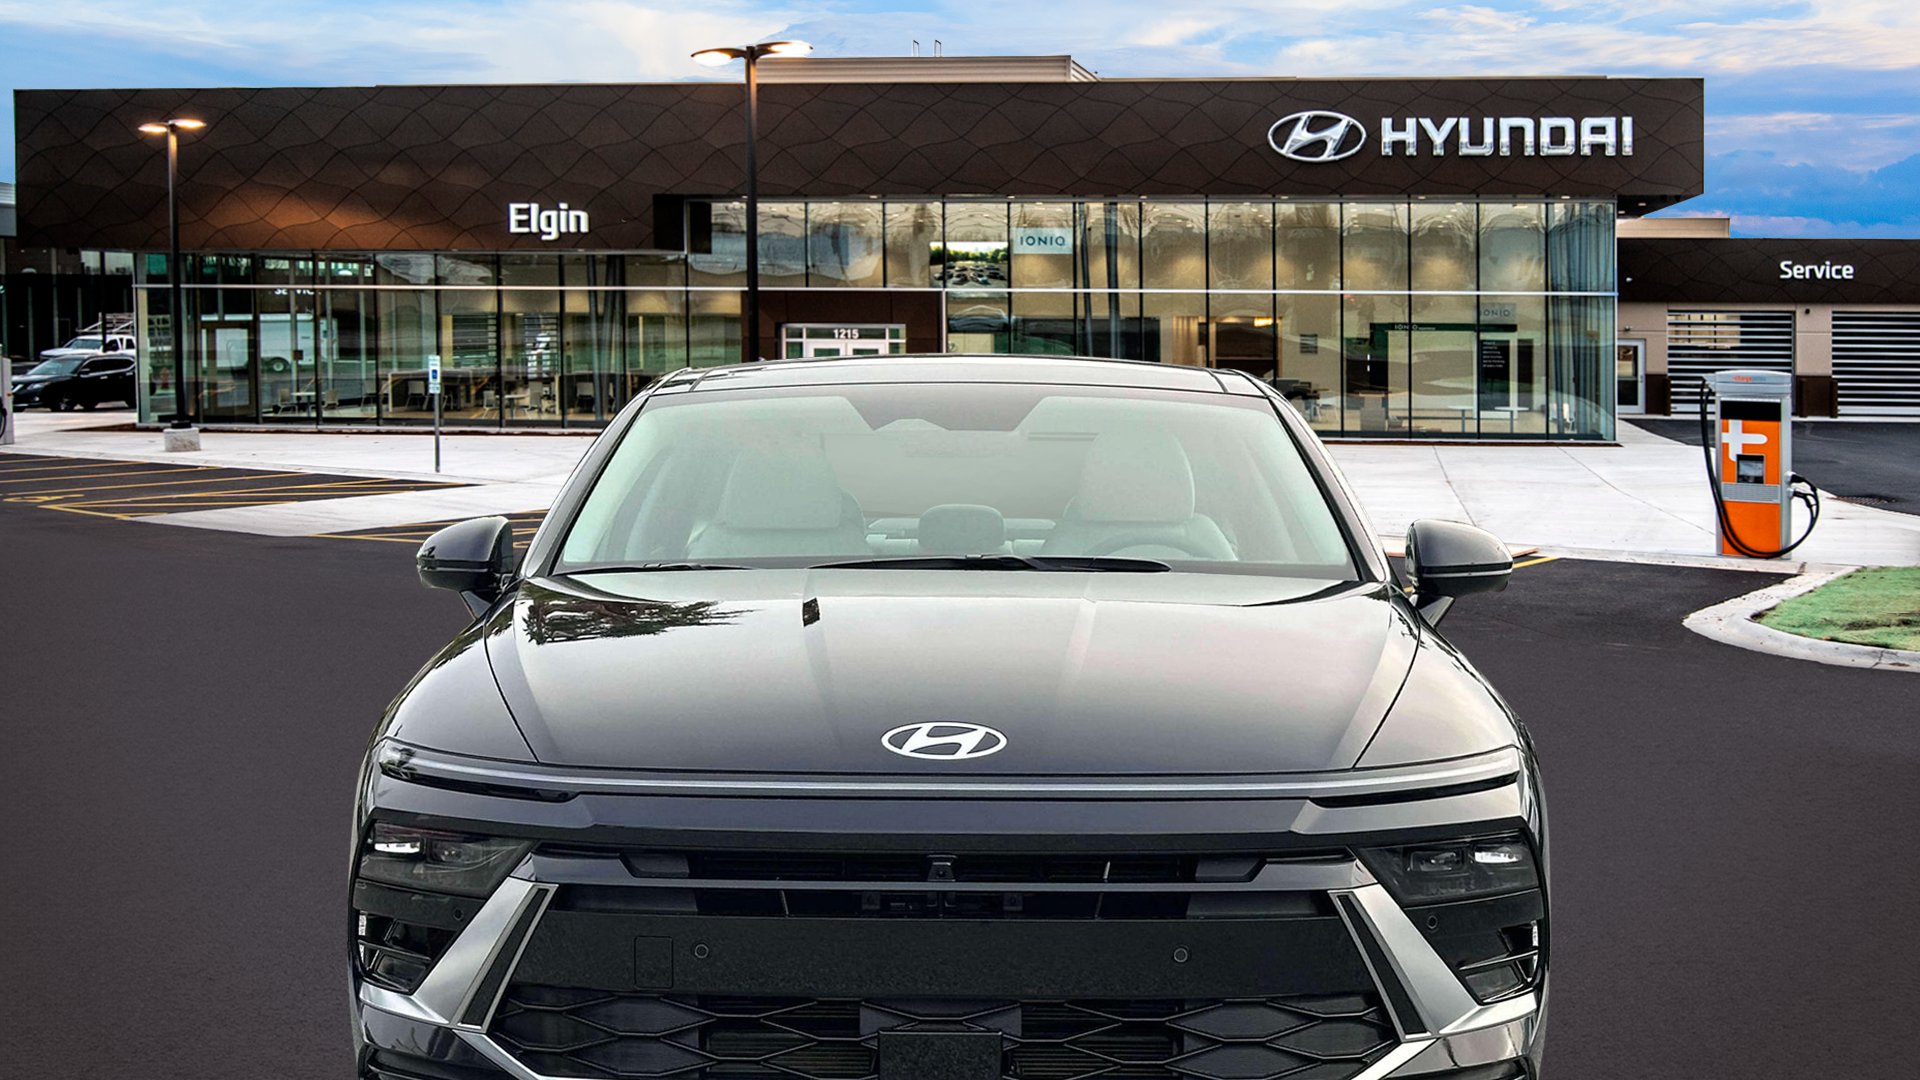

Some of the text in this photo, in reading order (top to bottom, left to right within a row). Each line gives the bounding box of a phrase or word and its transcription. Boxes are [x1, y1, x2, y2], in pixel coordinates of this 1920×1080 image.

[1381, 117, 1633, 156] HYUNDAI
[509, 203, 589, 240] Elgin
[1020, 235, 1065, 246] IONIQ
[1779, 260, 1855, 279] Service
[833, 328, 859, 339] 1215
